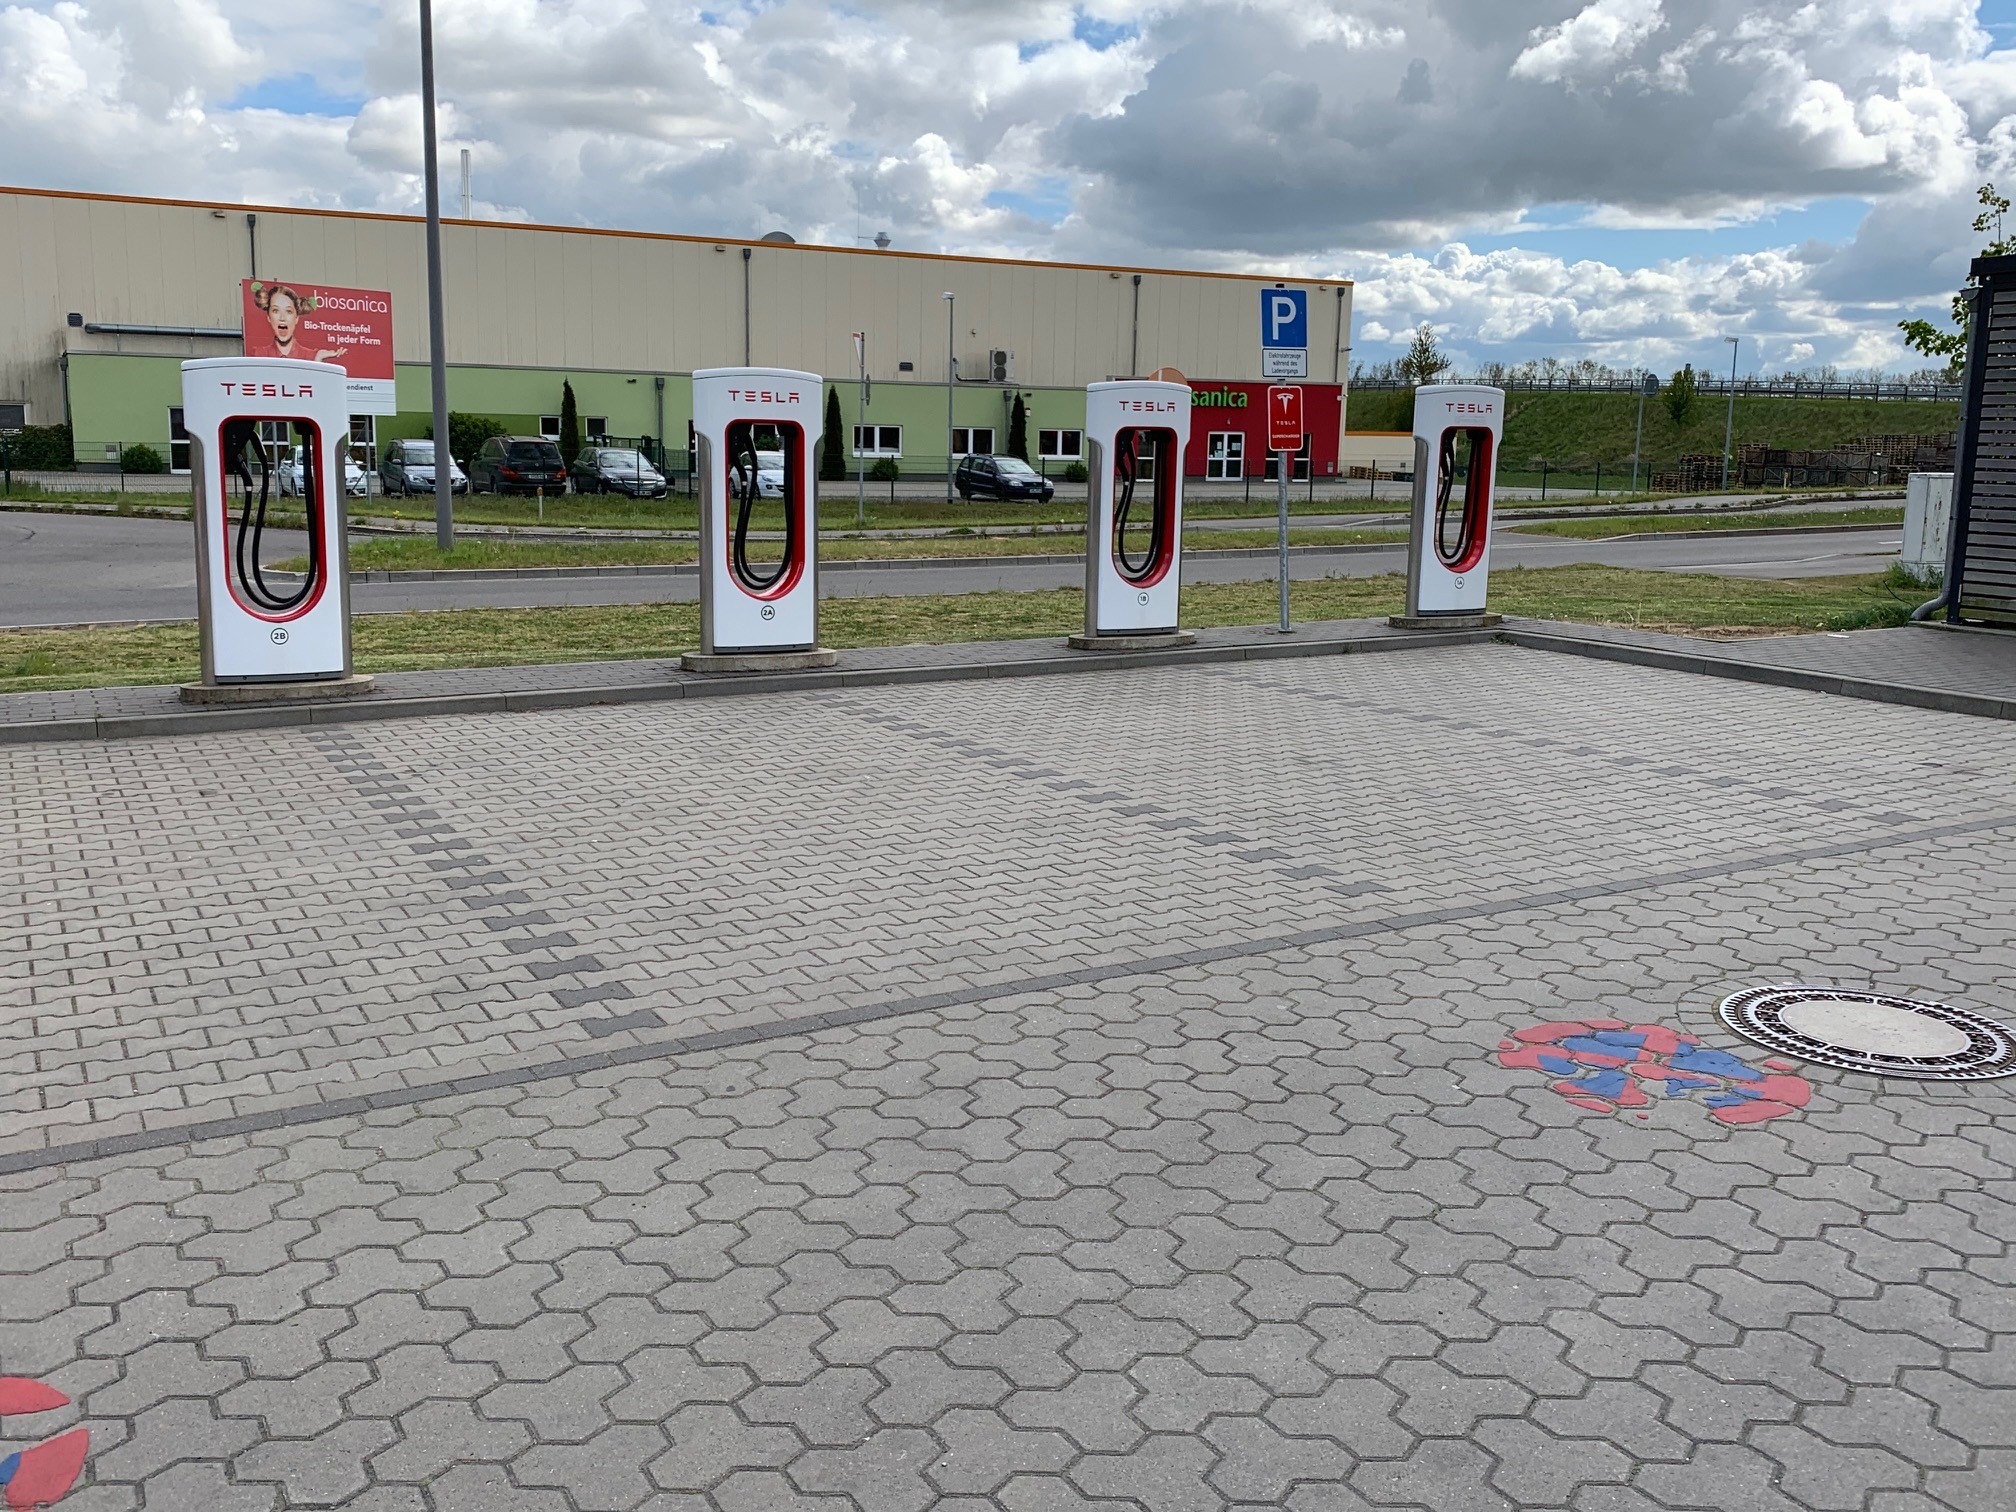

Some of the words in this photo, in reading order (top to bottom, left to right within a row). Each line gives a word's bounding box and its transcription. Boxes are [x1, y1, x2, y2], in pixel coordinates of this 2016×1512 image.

[313, 289, 388, 313] biosanica
[1271, 296, 1297, 341] P
[304, 320, 371, 335] Bio-Trockenäpfel
[327, 333, 336, 343] in
[336, 334, 358, 345] jeder
[360, 335, 381, 346] Form
[220, 382, 313, 398] TESLA
[728, 389, 800, 404] TESLA
[1191, 385, 1248, 408] sanica
[1119, 400, 1176, 412] TESLA
[1445, 402, 1493, 414] TESLA
[273, 632, 286, 640] 2B
